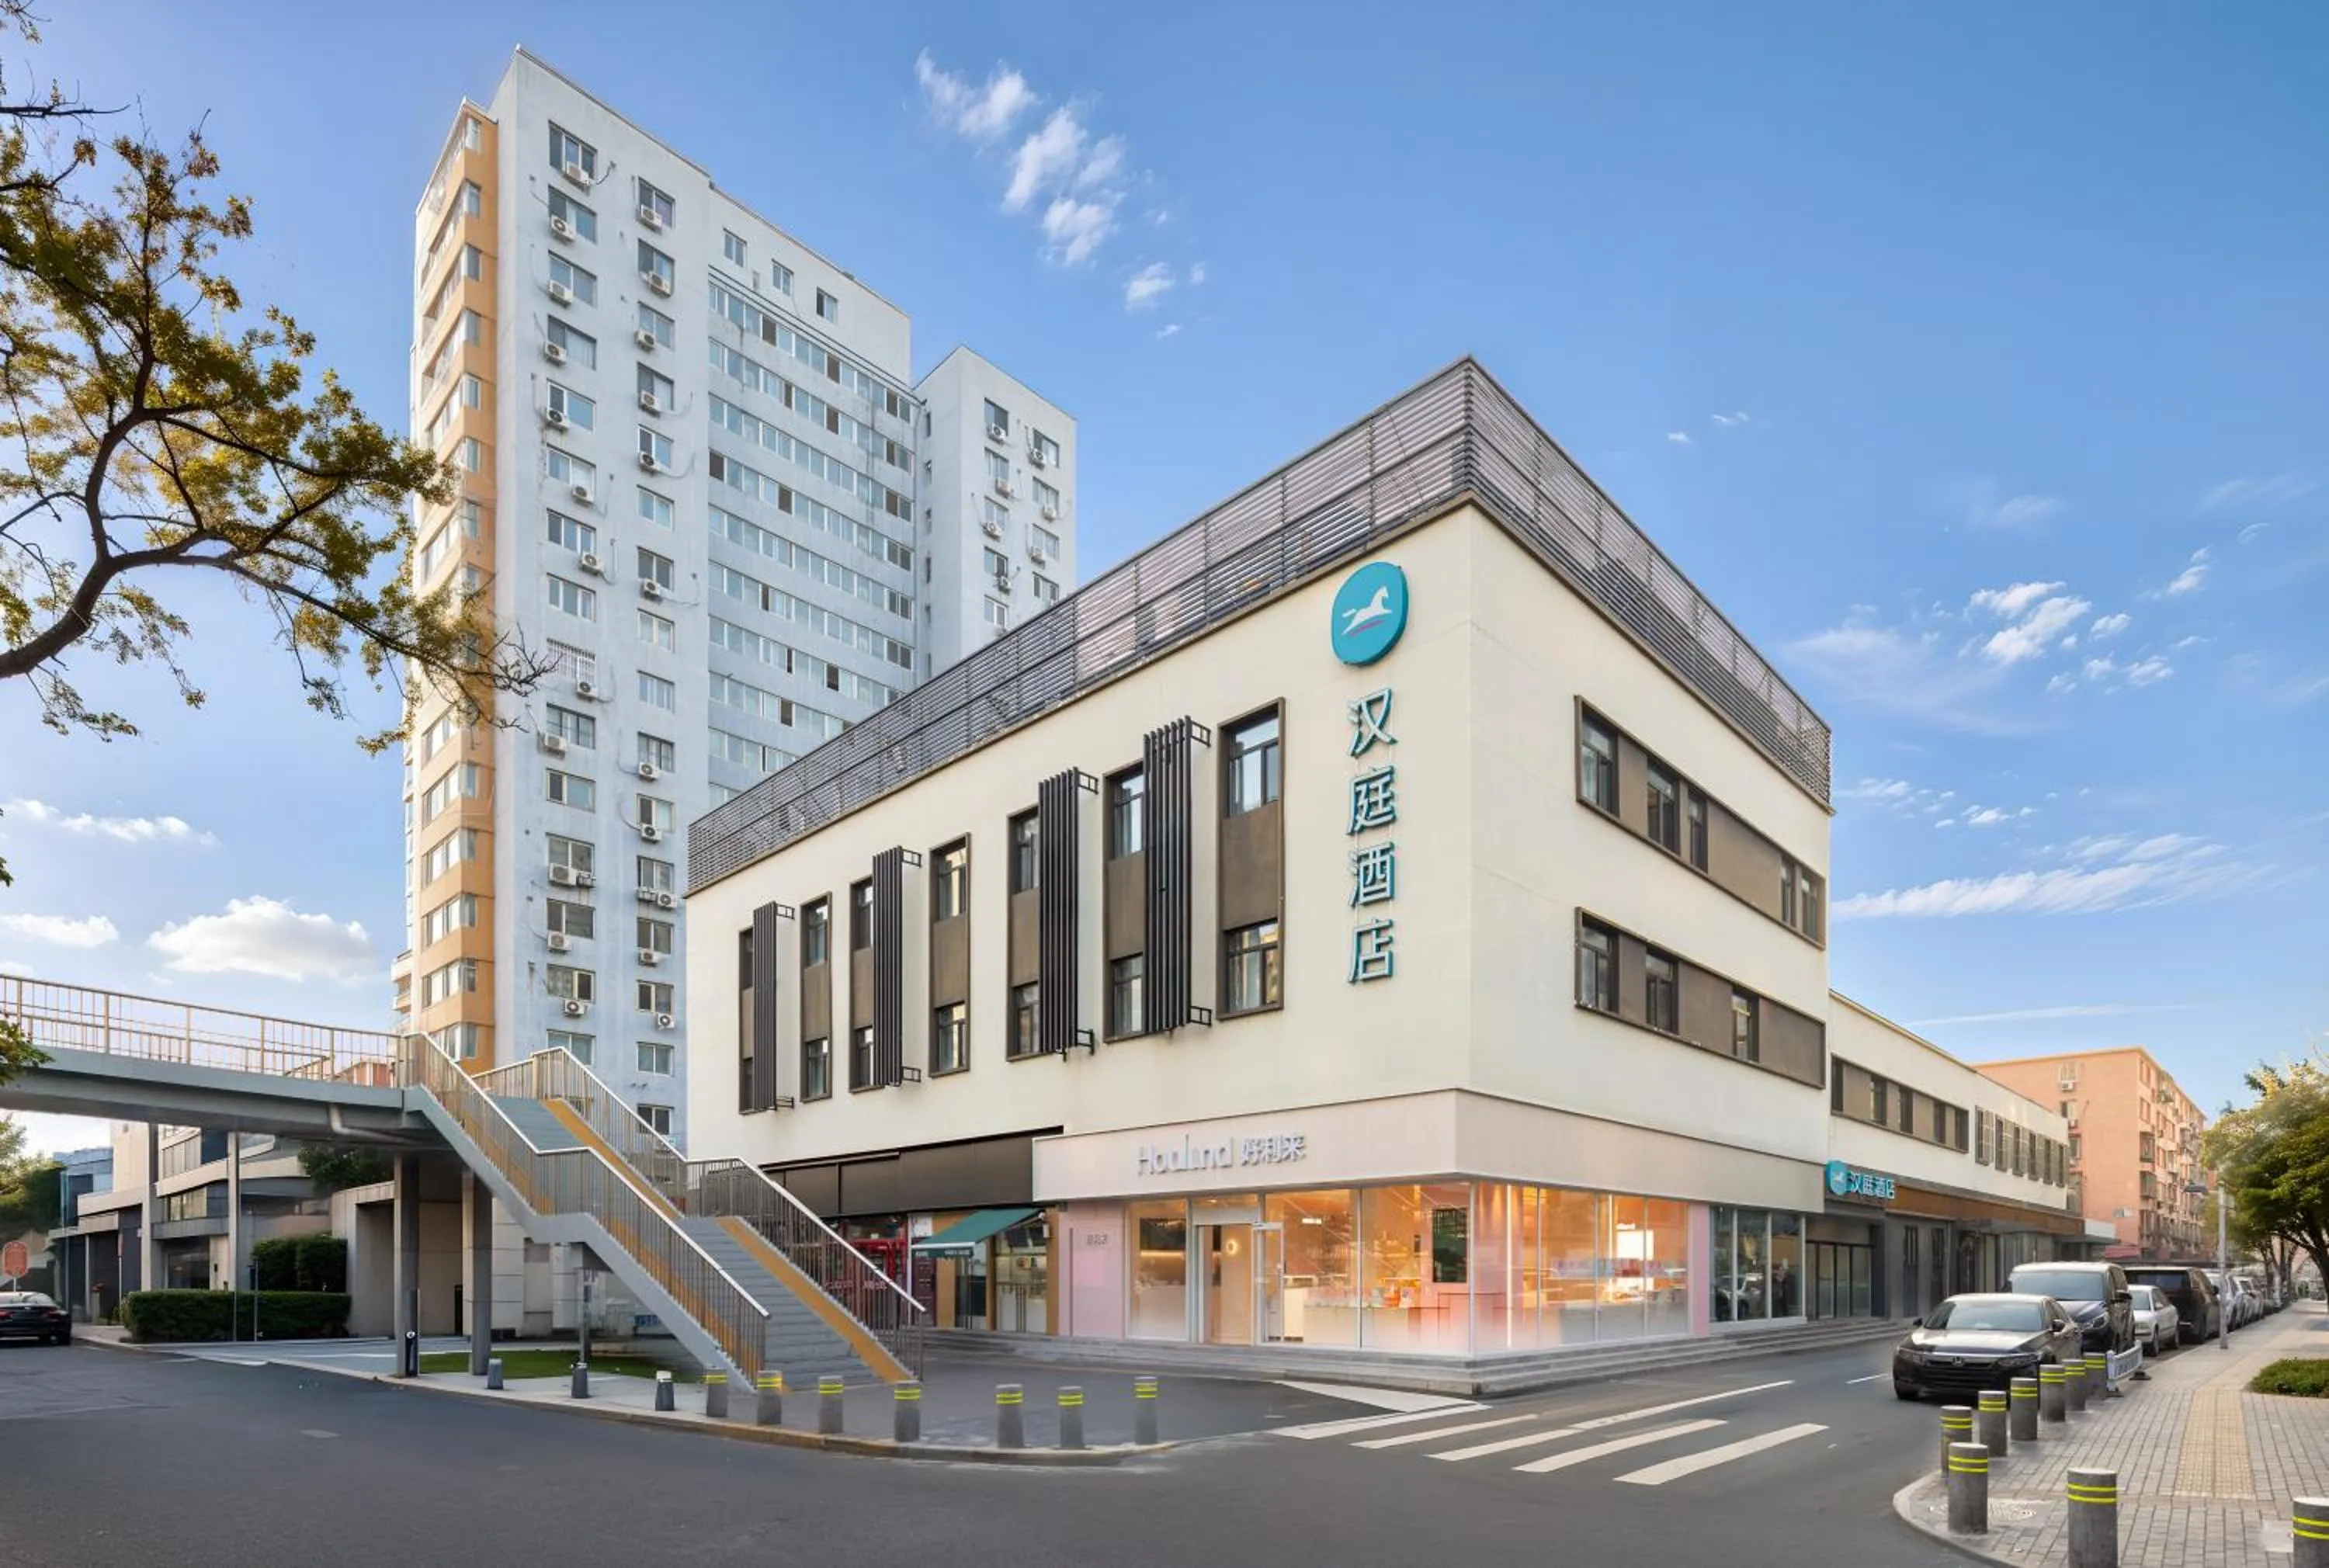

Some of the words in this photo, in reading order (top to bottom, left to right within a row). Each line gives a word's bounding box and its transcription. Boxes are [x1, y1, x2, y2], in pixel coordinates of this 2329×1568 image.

[1347, 687, 1397, 984] 汉庭酒店
[1847, 1171, 1895, 1199] 汉庭酒店
